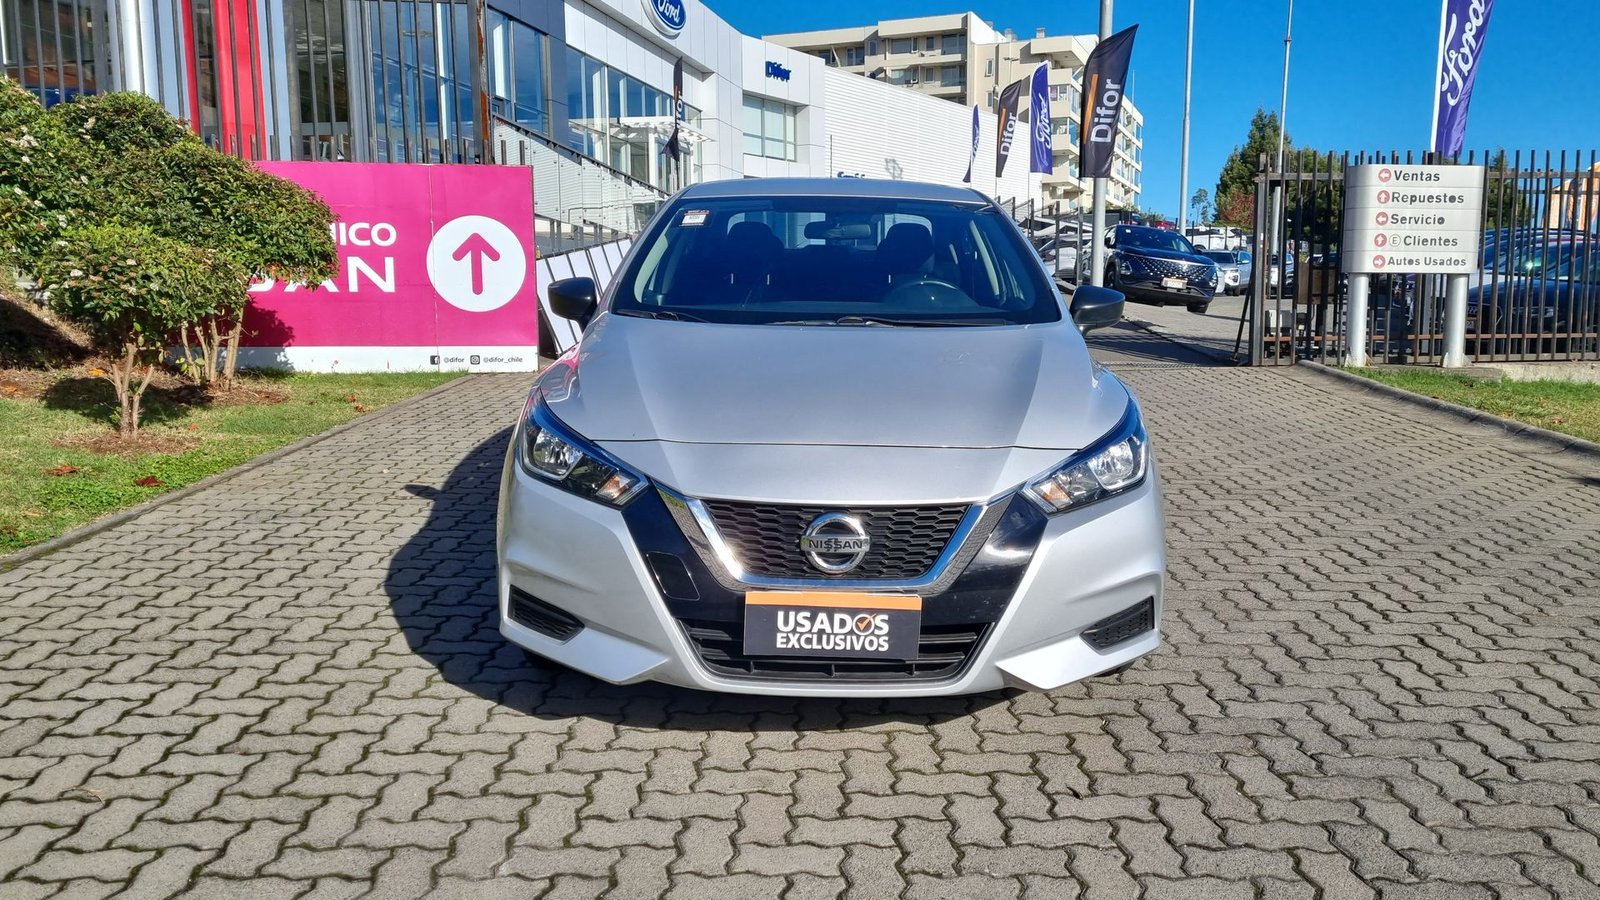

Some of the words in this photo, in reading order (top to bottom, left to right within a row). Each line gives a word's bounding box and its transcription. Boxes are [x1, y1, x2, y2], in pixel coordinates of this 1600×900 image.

[765, 61, 792, 82] Difor
[1090, 78, 1121, 143] Difor
[1035, 93, 1053, 150] Ford
[1000, 113, 1018, 155] Difor
[1394, 169, 1441, 182] Ventas
[1391, 191, 1465, 205] Repuestos
[1390, 213, 1446, 225] Servicio
[1403, 235, 1459, 247] Clientes
[1387, 256, 1420, 266] Autos
[1424, 257, 1467, 267] Usados
[809, 538, 864, 551] NISSAN
[777, 610, 890, 636] USADOS
[776, 633, 889, 651] EXCLUSIVOS
